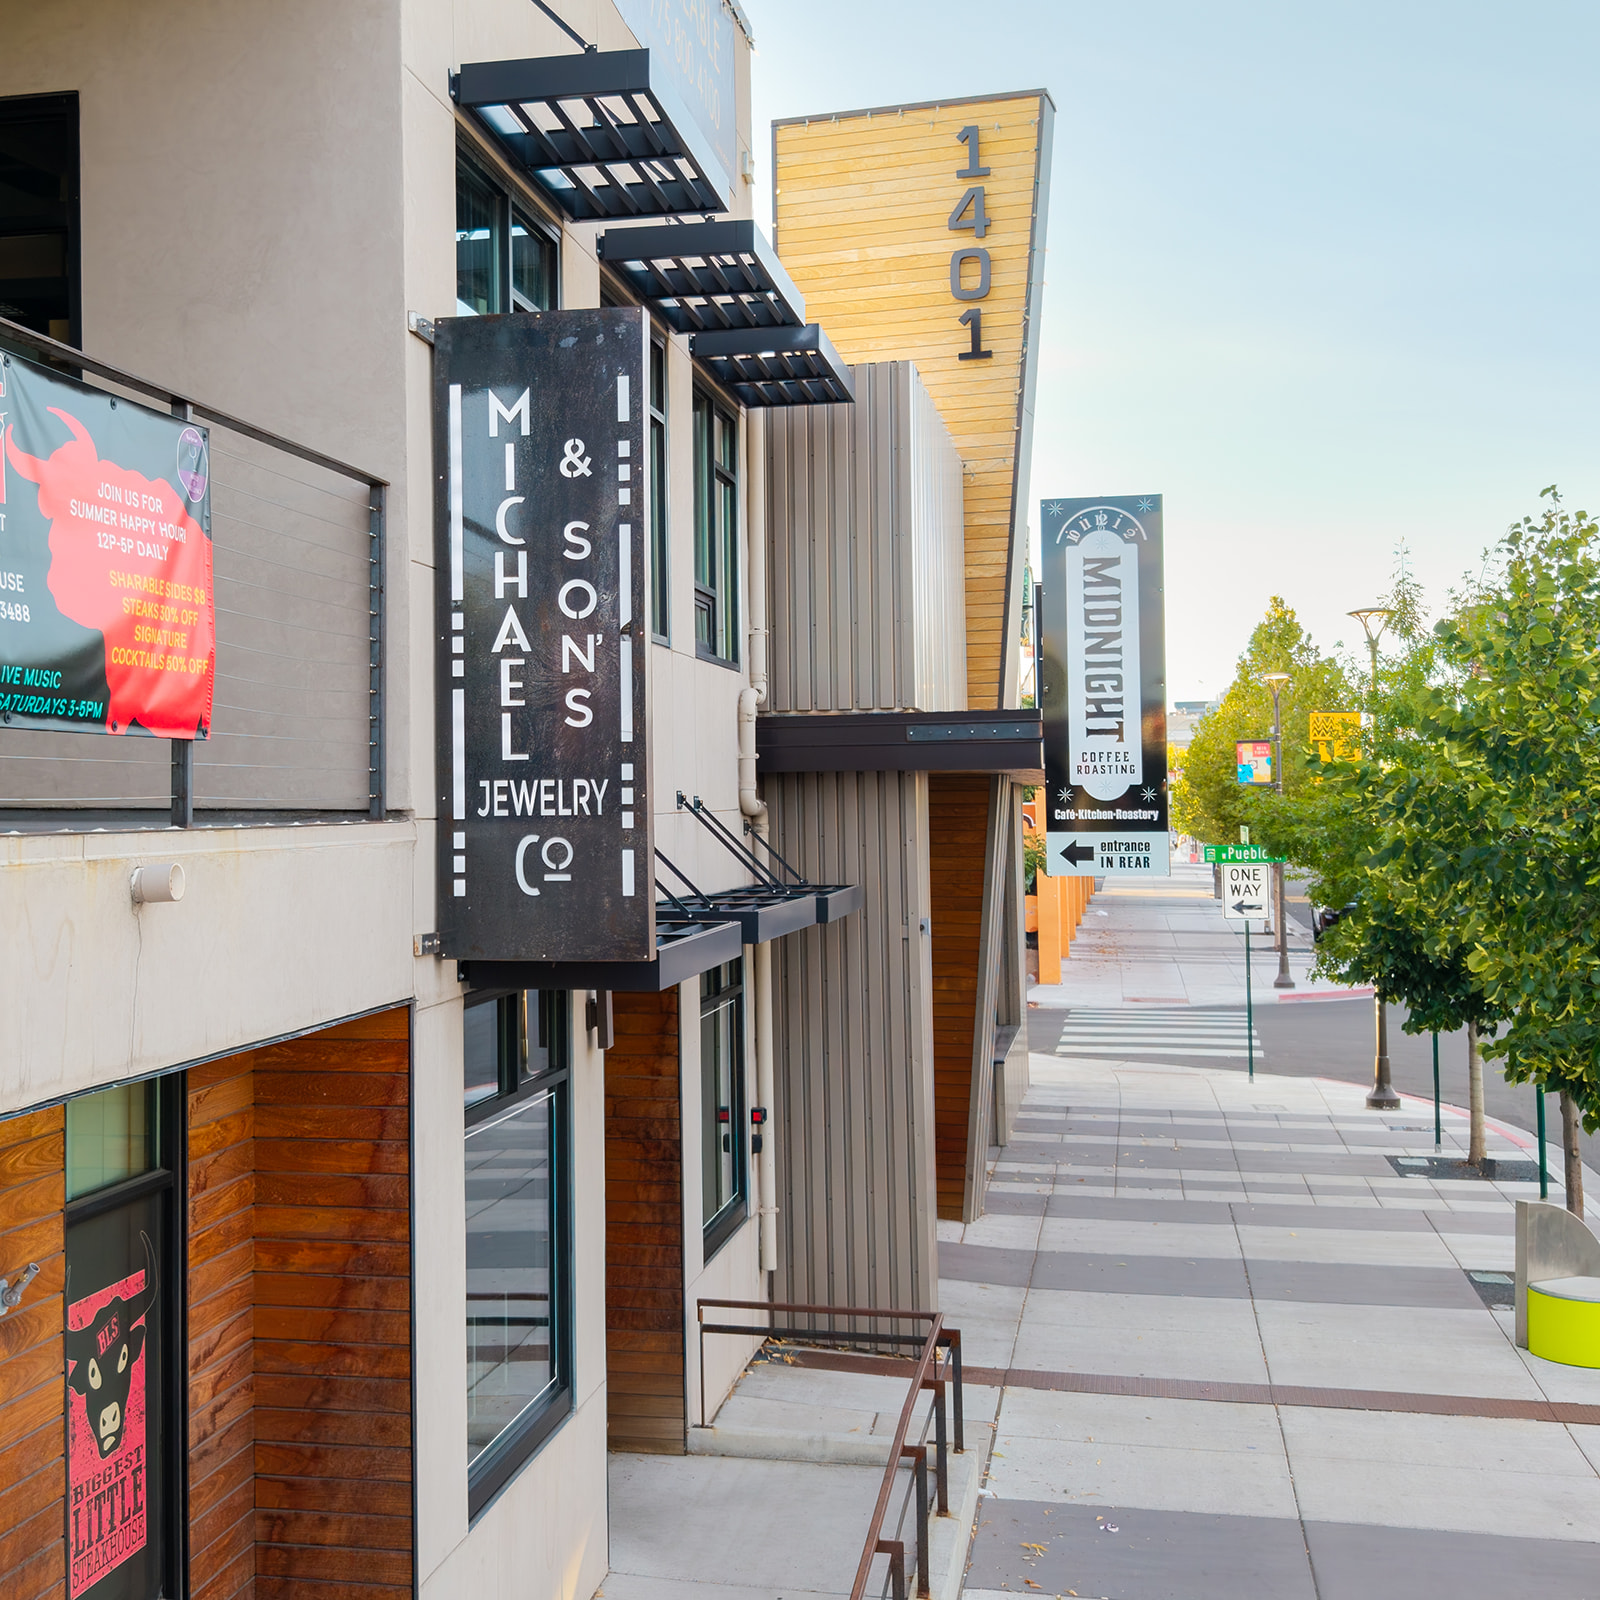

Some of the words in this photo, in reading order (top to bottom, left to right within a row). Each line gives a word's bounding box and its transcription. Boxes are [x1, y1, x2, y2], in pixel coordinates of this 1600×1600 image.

[948, 125, 992, 361] 1401
[559, 438, 593, 479] &
[97, 481, 122, 504] JOIN
[125, 489, 140, 509] US
[141, 493, 164, 514] FOR
[69, 498, 118, 528] SUMMER
[119, 511, 156, 536] HAPPY
[158, 521, 187, 544] HOUR!
[97, 531, 134, 554] 12P-5P
[137, 540, 169, 561] DAILY
[0, 571, 25, 593] USE
[109, 569, 165, 597] SHARABLE
[165, 581, 193, 602] SIDES
[193, 586, 206, 606] $8
[488, 387, 531, 761] MICHAEL
[0, 600, 31, 623] 3488
[122, 596, 160, 620] STEAKS
[159, 604, 179, 623] 30%
[180, 608, 199, 626] OFF
[134, 624, 188, 649] SIGNATURE
[1082, 556, 1126, 744] MIDNIGHT
[111, 646, 165, 670] COCKTAILS
[166, 654, 187, 673] 50%
[188, 657, 209, 675] OFF
[23, 667, 62, 689] MUSIC
[0, 692, 67, 716] SATURDAYS
[68, 699, 104, 719] 3-5PM
[1076, 764, 1136, 775] ROASTING
[1081, 751, 1130, 763] COFFEE
[477, 778, 609, 817] JEWELRY
[1100, 840, 1151, 852] entrance
[1100, 856, 1114, 868] IN
[1119, 856, 1151, 868] REAR
[1230, 868, 1261, 882] ONE
[1230, 883, 1262, 897] WAY
[97, 1315, 119, 1356] BLS
[72, 1443, 144, 1507] BIGGEST
[72, 1463, 144, 1560] LITTLE
[72, 1513, 145, 1590] STEAKHOUSE
